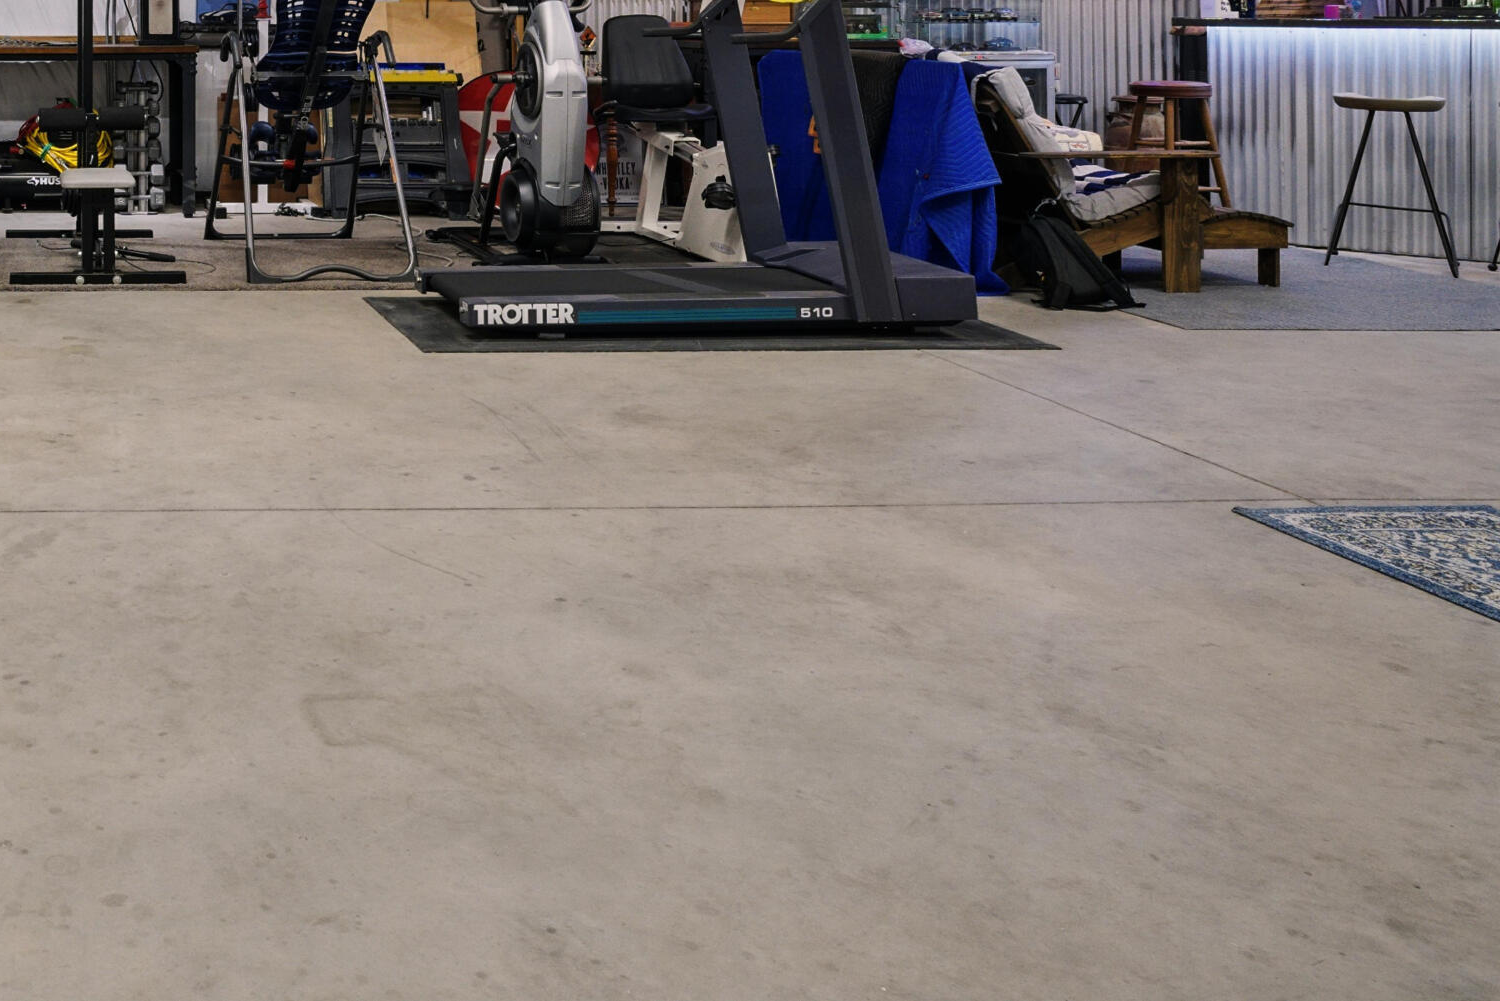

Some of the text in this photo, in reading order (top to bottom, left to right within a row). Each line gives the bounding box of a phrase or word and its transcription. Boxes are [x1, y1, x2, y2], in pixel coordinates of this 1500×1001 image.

[596, 161, 636, 176] WHTLEY
[602, 176, 631, 191] VDKA
[473, 302, 576, 326] TROTTER
[800, 306, 834, 319] 510
